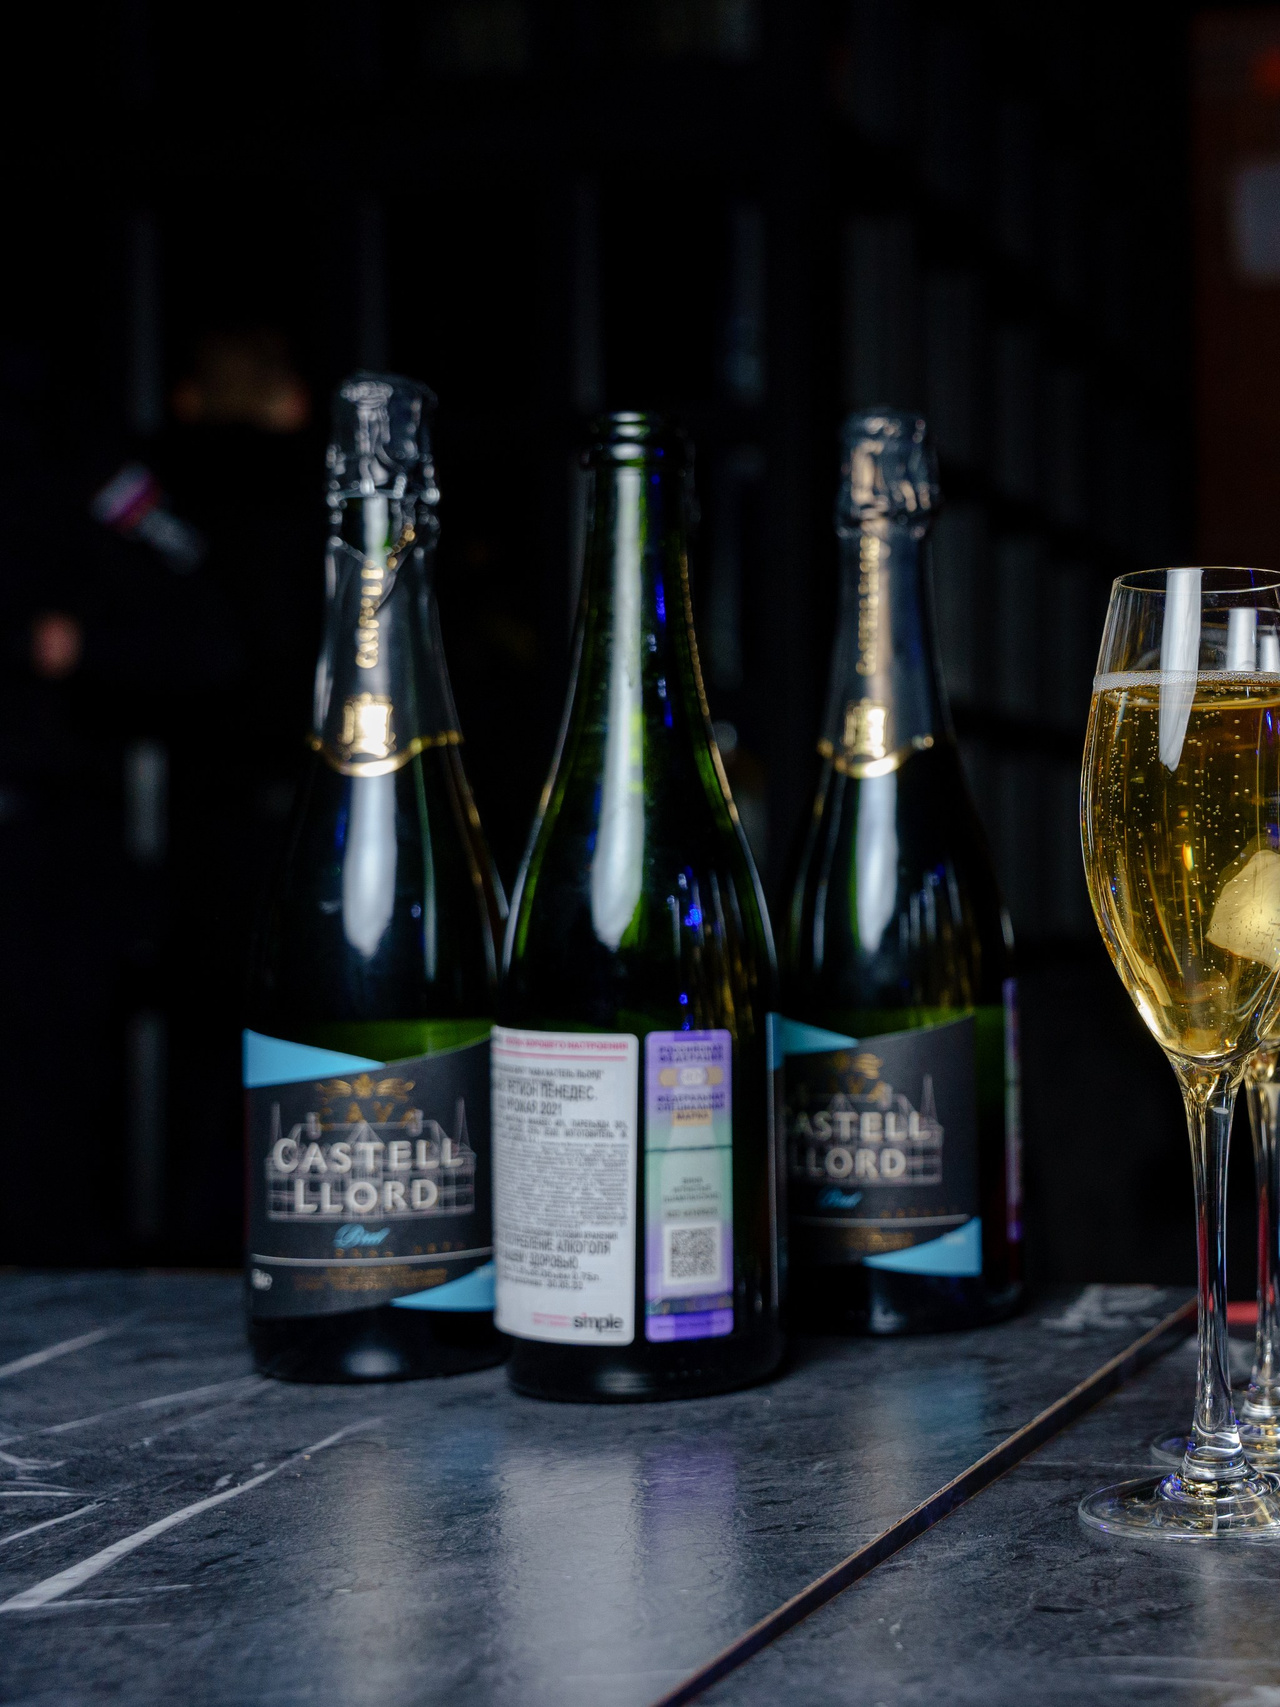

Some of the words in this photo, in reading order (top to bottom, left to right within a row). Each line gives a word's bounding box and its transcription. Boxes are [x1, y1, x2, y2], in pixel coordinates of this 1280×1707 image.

[795, 1109, 932, 1143] ASTELL
[272, 1137, 465, 1174] CASTELL
[293, 1178, 439, 1214] LLORD
[573, 1312, 625, 1333] simple
